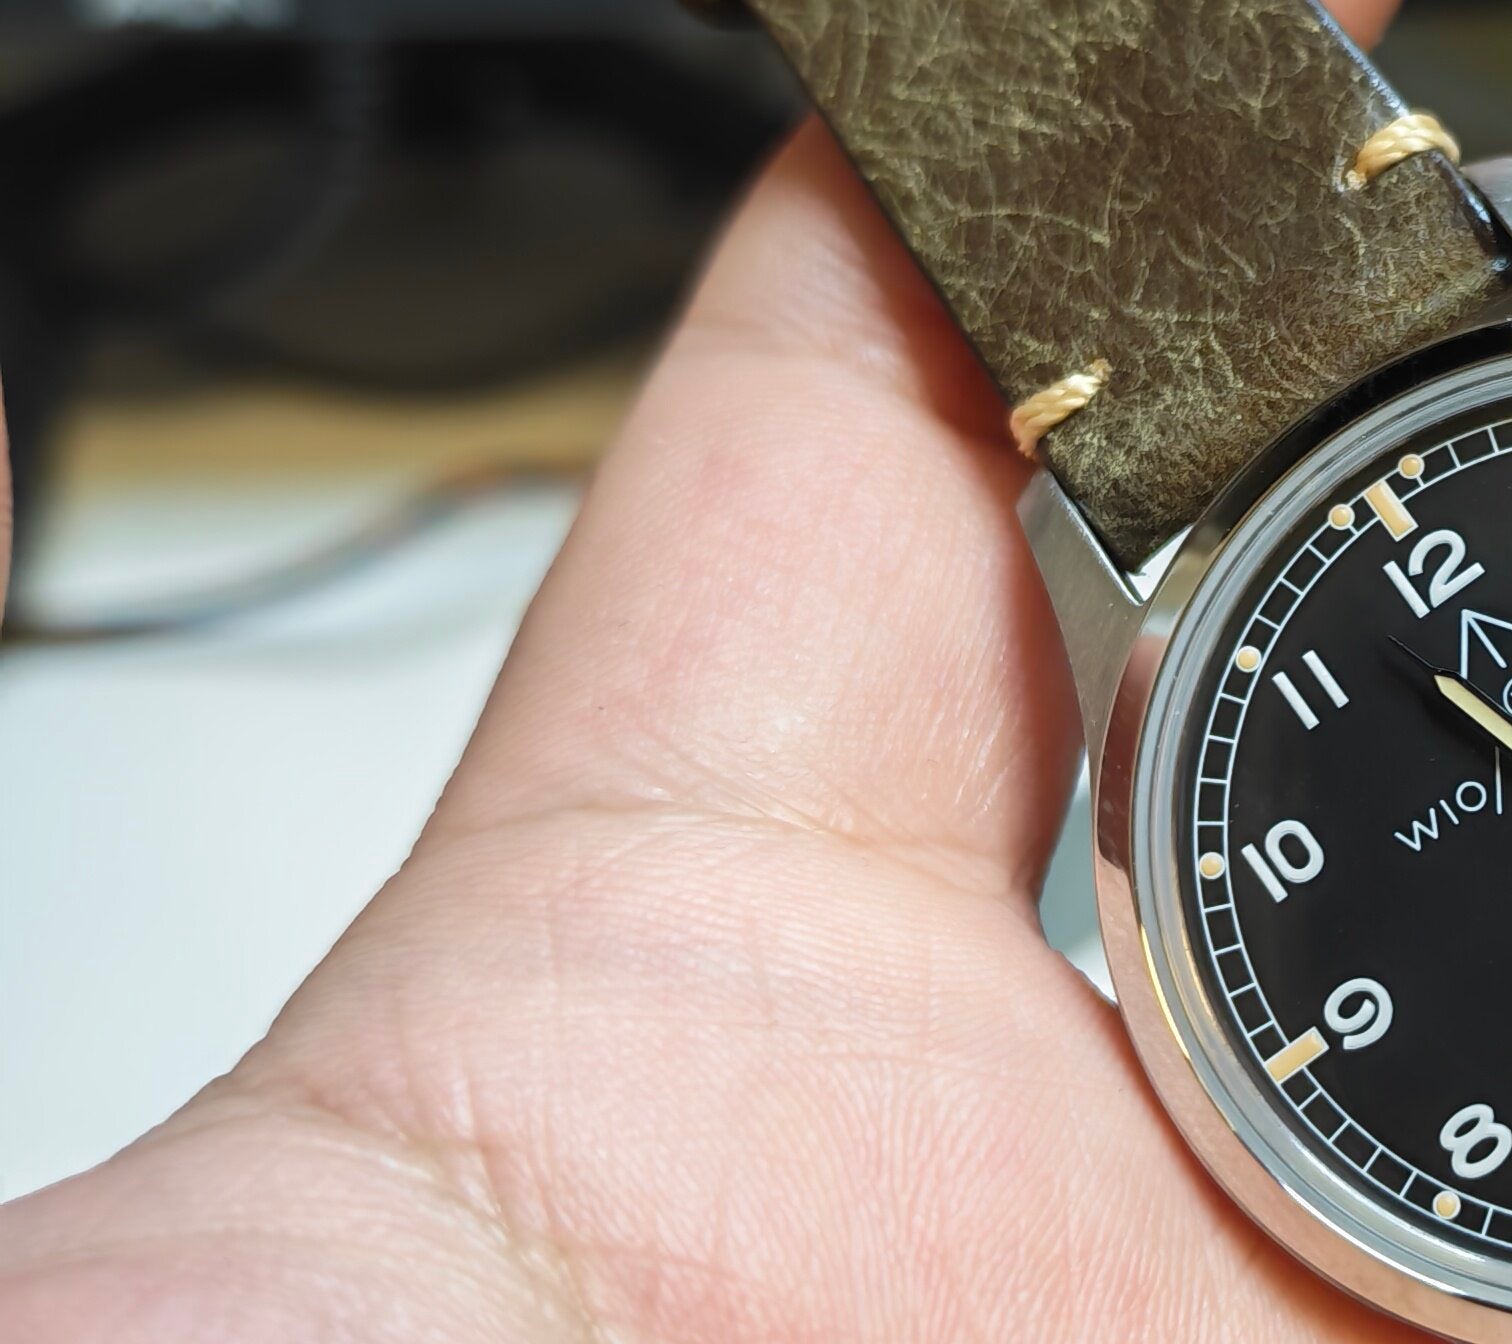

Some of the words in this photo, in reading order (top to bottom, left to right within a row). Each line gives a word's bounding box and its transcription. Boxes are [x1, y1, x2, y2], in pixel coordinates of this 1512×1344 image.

[1382, 529, 1486, 619] 12
[1271, 649, 1350, 730] 11
[1240, 819, 1325, 903] 10
[1323, 977, 1394, 1050] 9
